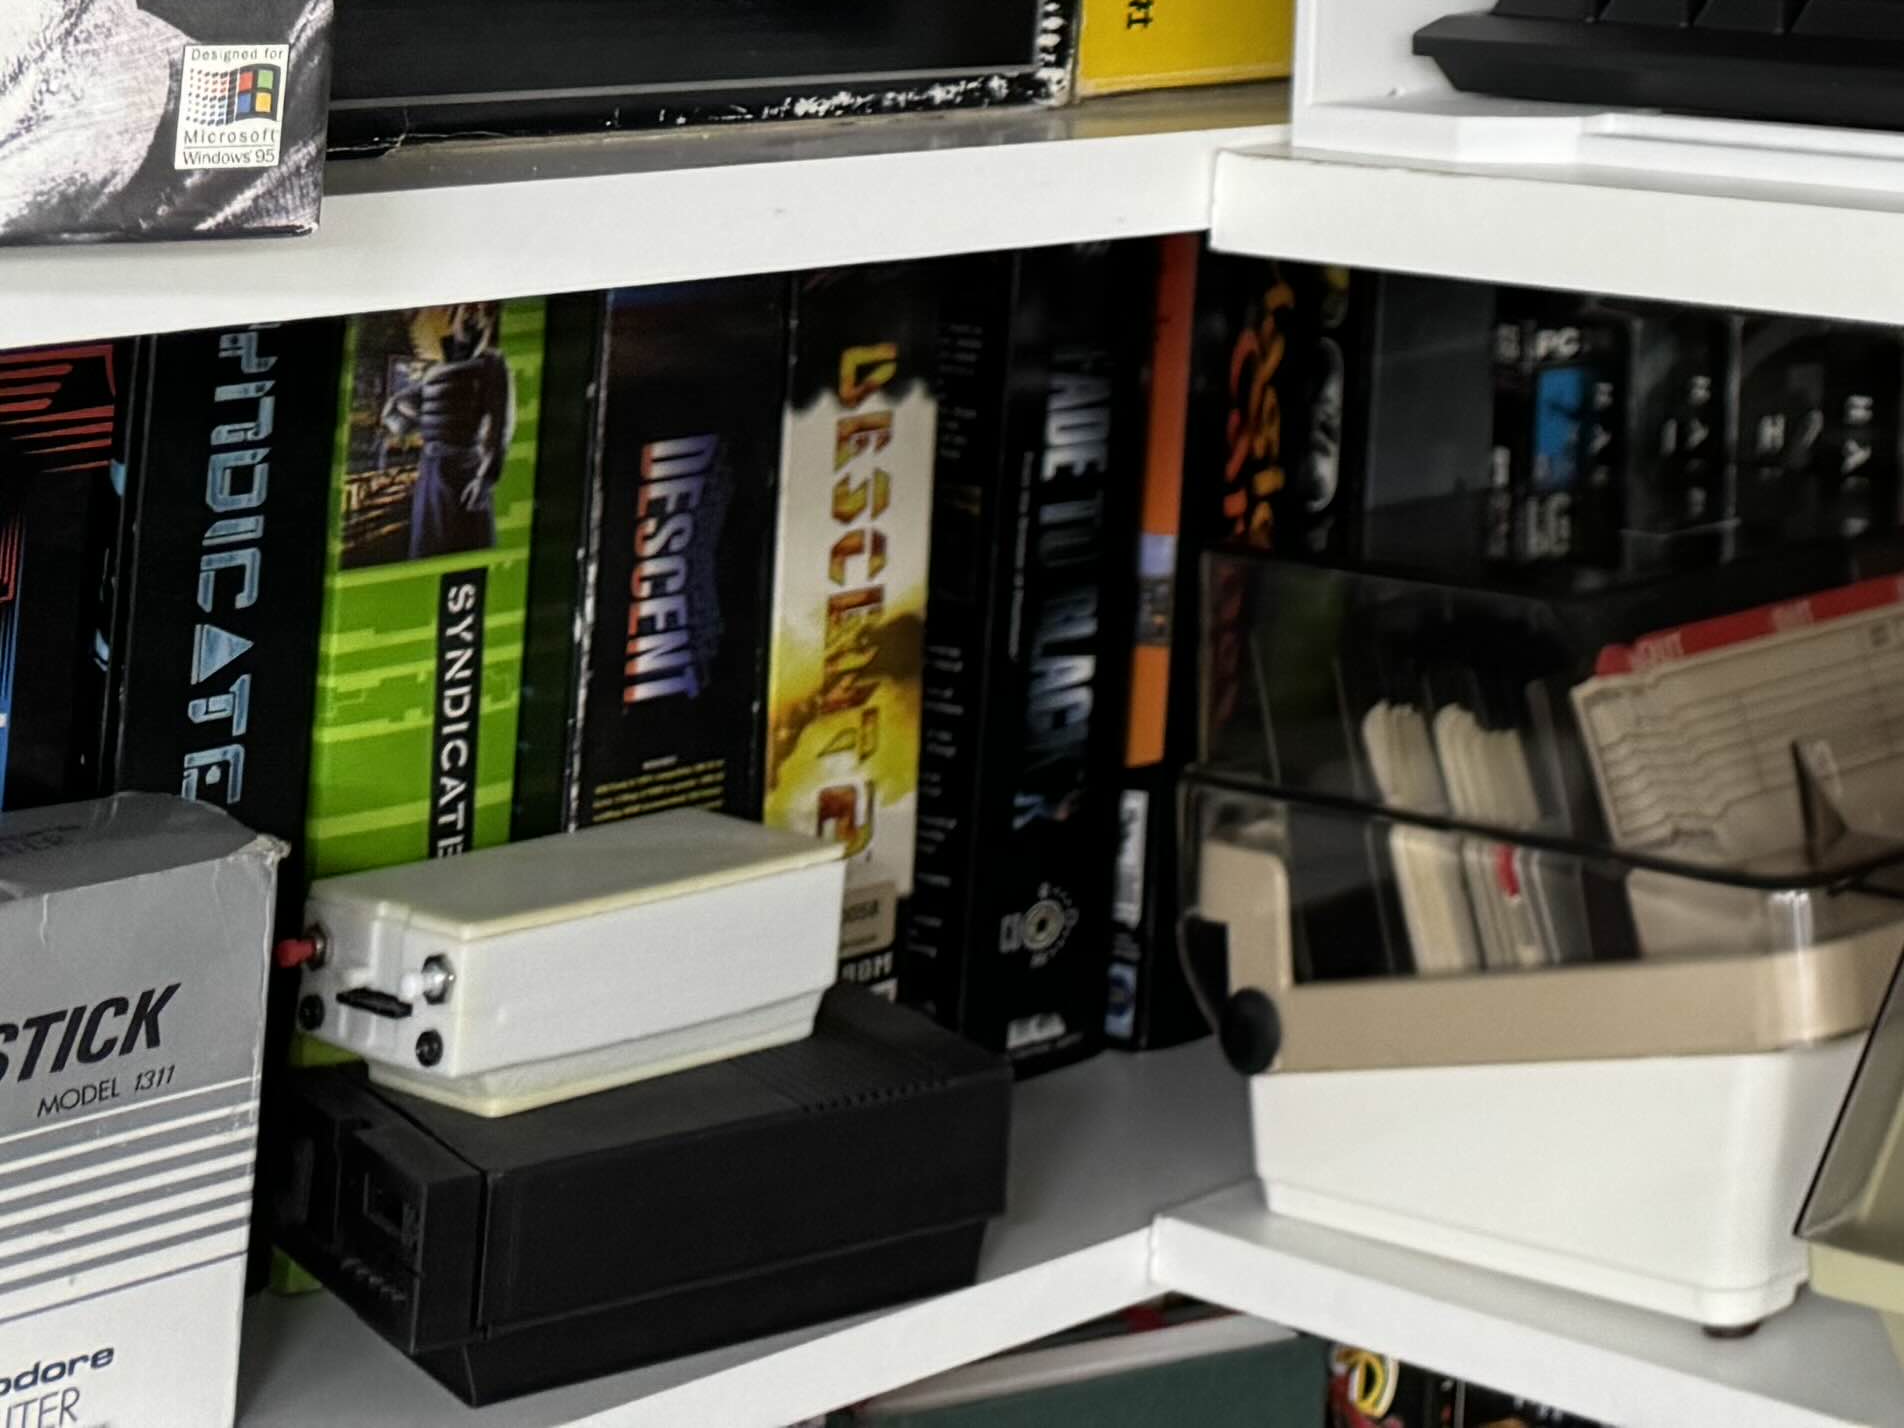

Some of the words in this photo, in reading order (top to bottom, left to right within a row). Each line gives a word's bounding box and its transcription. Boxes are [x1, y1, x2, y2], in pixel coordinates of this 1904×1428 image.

[191, 48, 257, 62] Designed
[264, 48, 284, 59] for
[184, 128, 276, 144] Microsoft
[181, 322, 280, 804] YNDICATE
[623, 434, 718, 704] DESCENT
[437, 582, 477, 859] SYNDICATE
[38, 1078, 120, 1118] MODEL
[135, 1065, 176, 1095] 1311
[3, 1386, 81, 1428] TER
